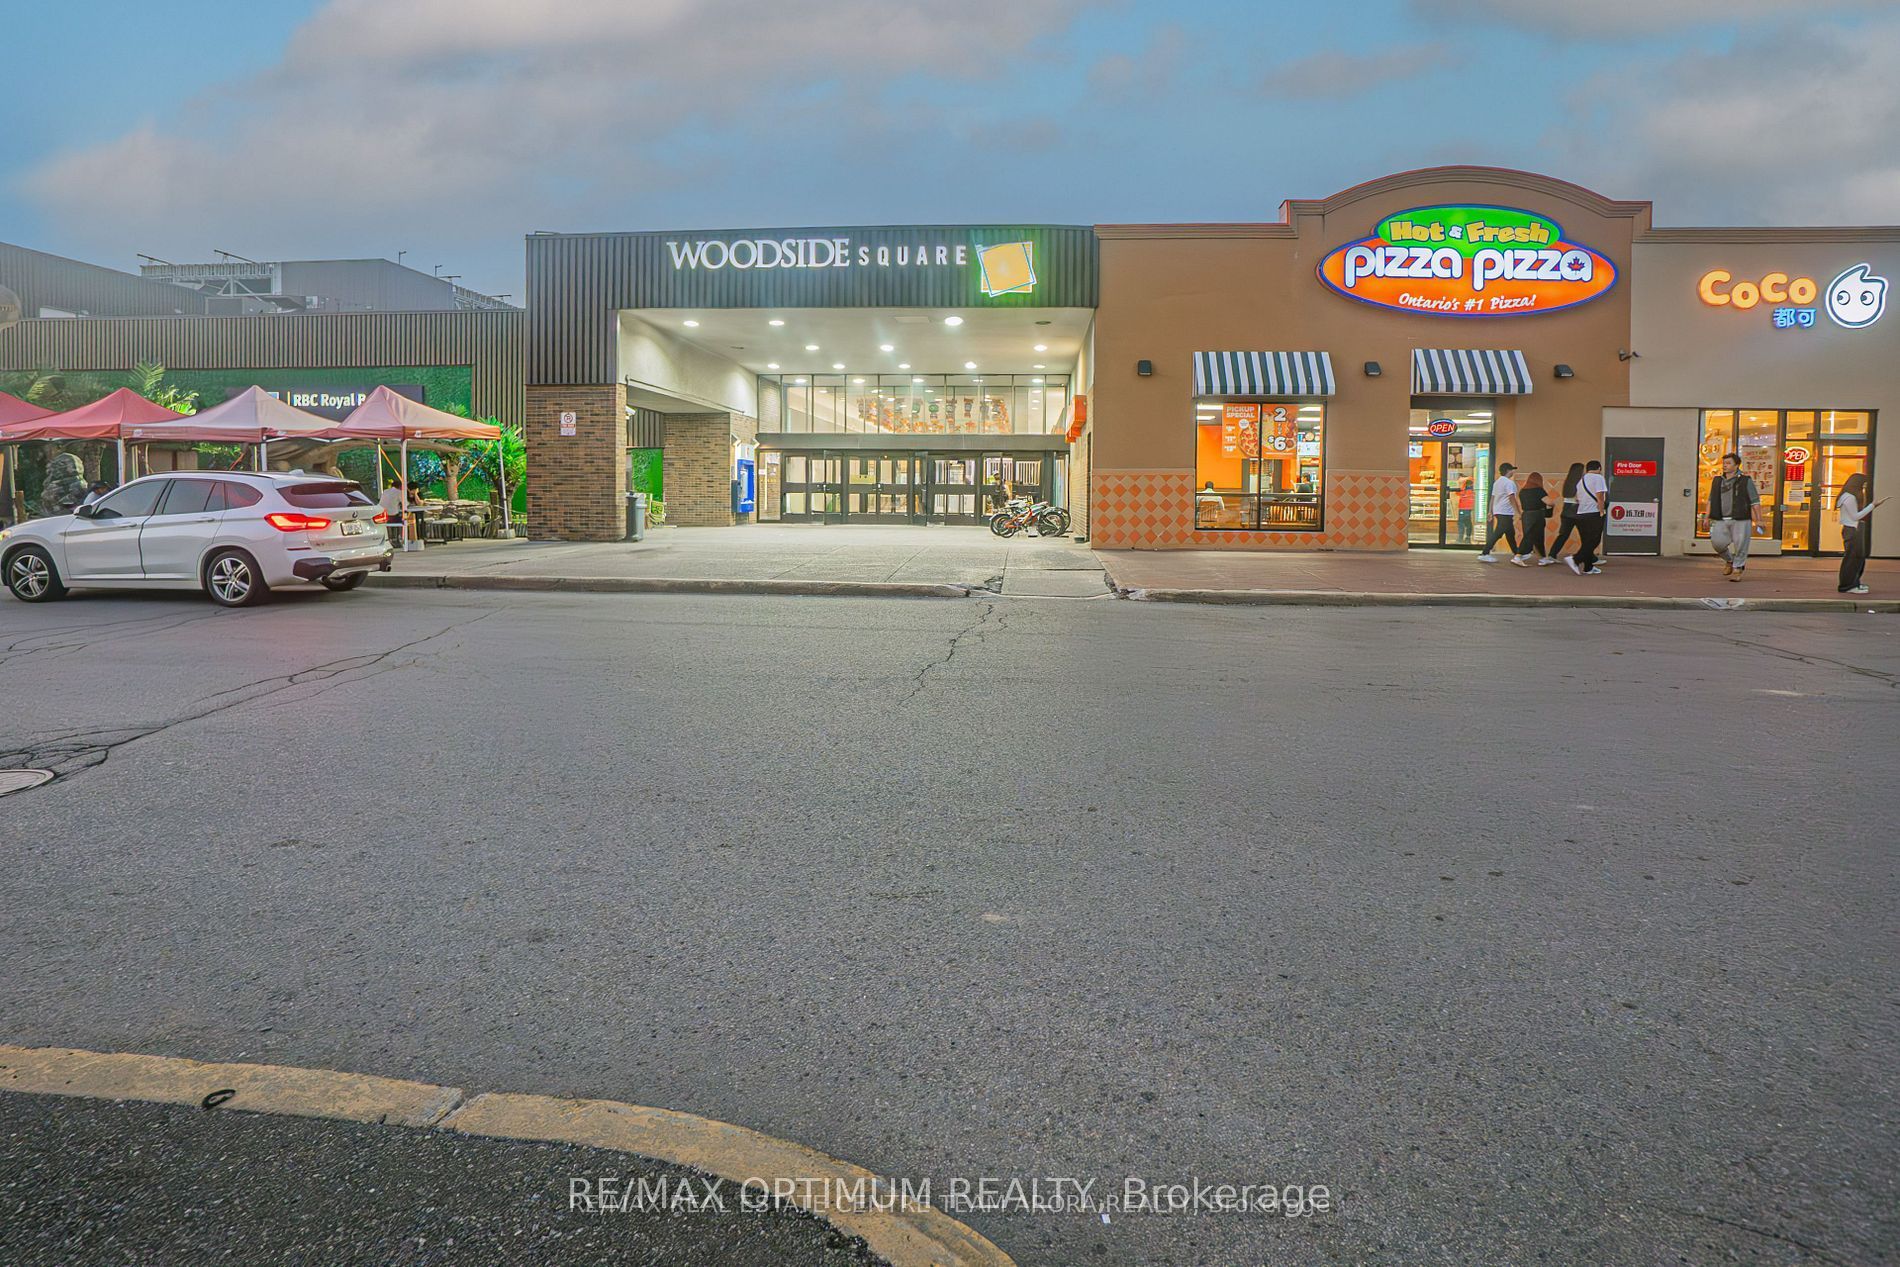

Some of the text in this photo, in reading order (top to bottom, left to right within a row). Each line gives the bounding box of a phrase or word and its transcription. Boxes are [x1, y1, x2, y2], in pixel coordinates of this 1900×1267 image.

[1389, 221, 1550, 244] Hot & Fresh
[666, 238, 967, 269] WOODSIDE SQUARE
[1699, 269, 1817, 309] CoCo
[1398, 293, 1537, 311] Ontario's #1 Pizza!
[1773, 308, 1817, 328] 都可
[293, 393, 319, 407] RBC
[320, 392, 355, 409] Royal
[1274, 407, 1287, 422] 2
[1430, 424, 1456, 432] OPEN
